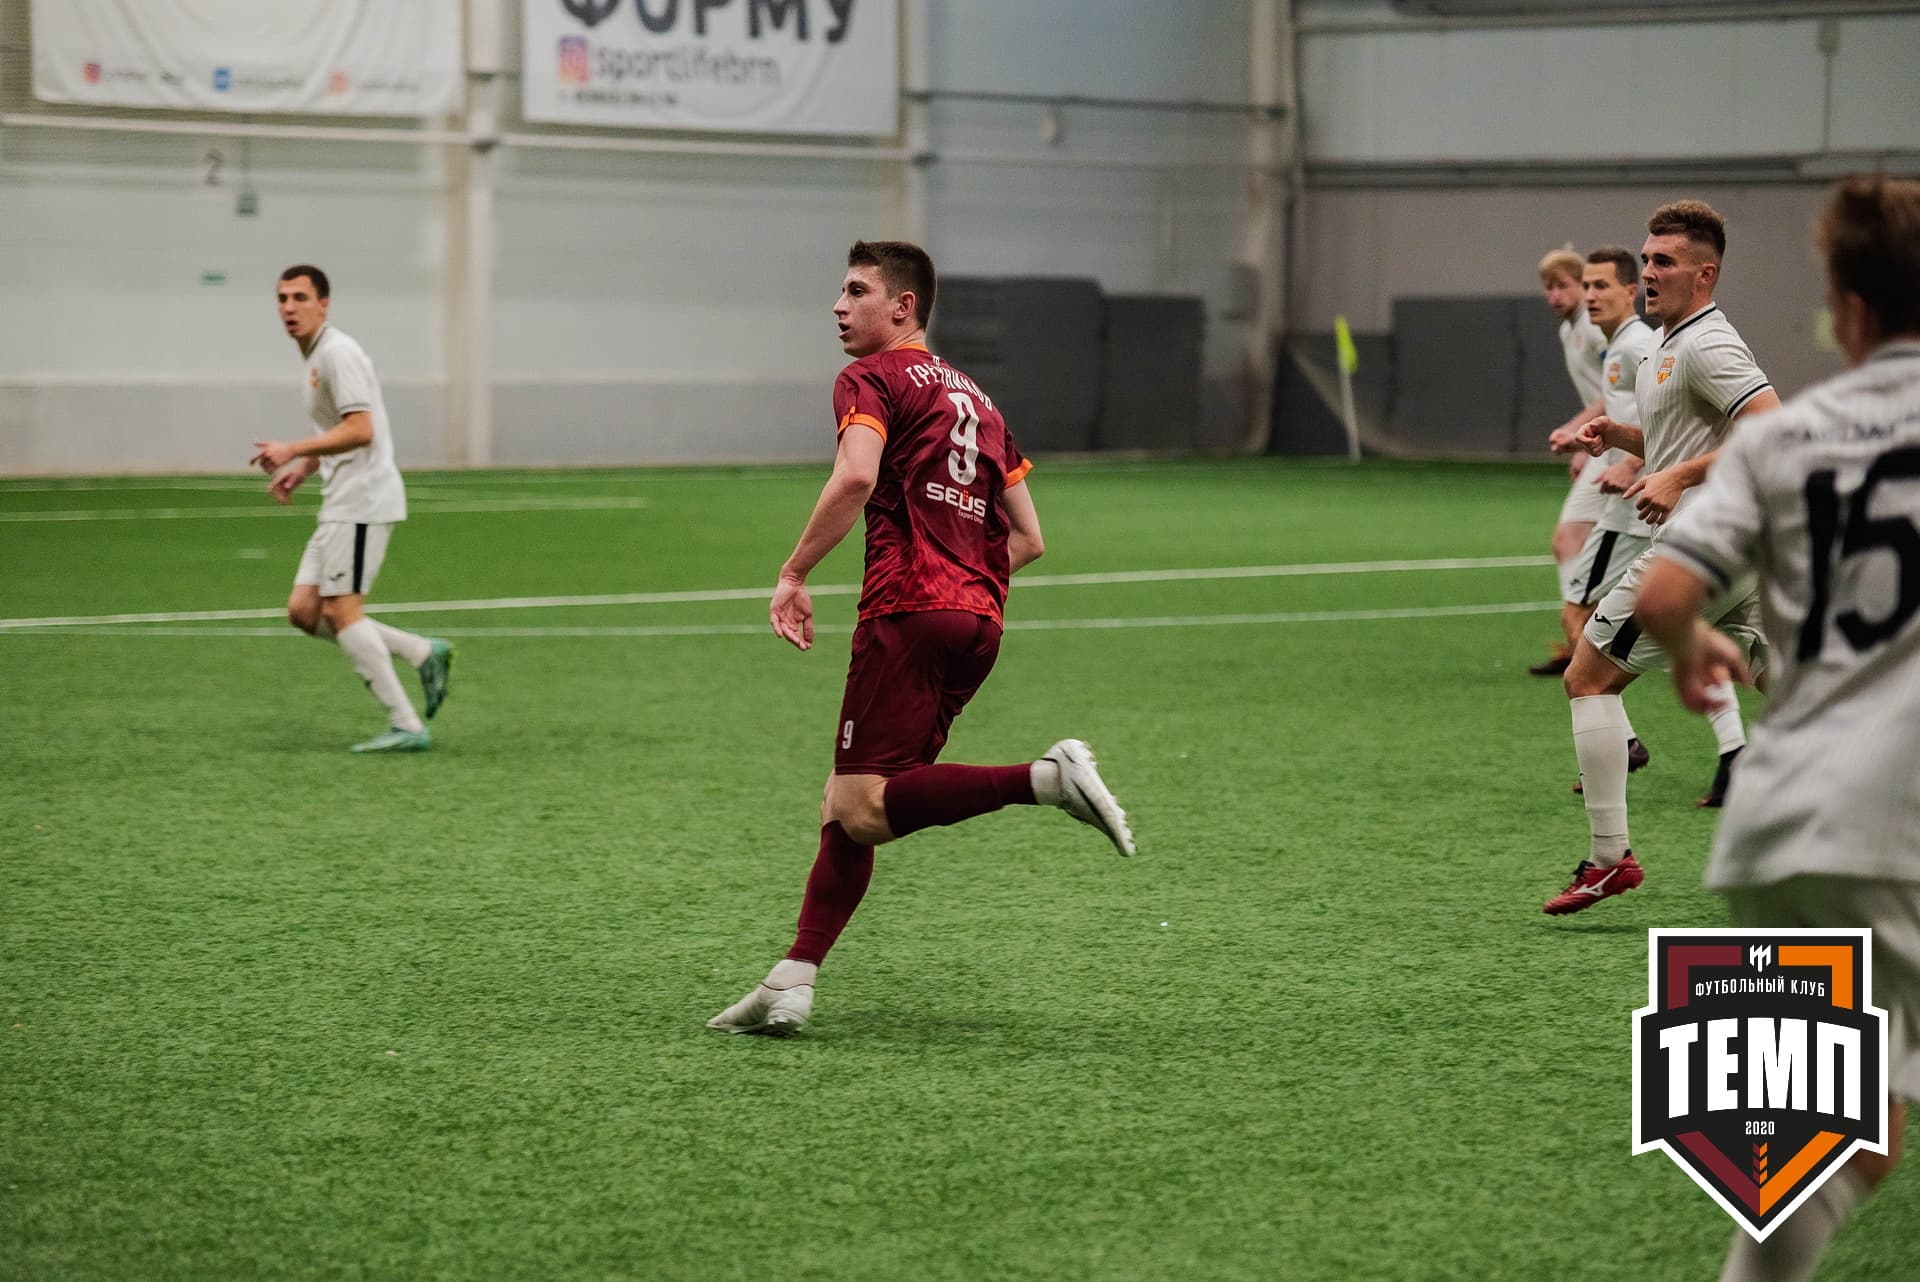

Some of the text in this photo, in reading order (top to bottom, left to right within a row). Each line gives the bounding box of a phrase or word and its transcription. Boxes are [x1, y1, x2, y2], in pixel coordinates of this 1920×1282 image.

[947, 392, 979, 486] 9
[1796, 442, 1920, 661] 15
[842, 720, 854, 749] 9
